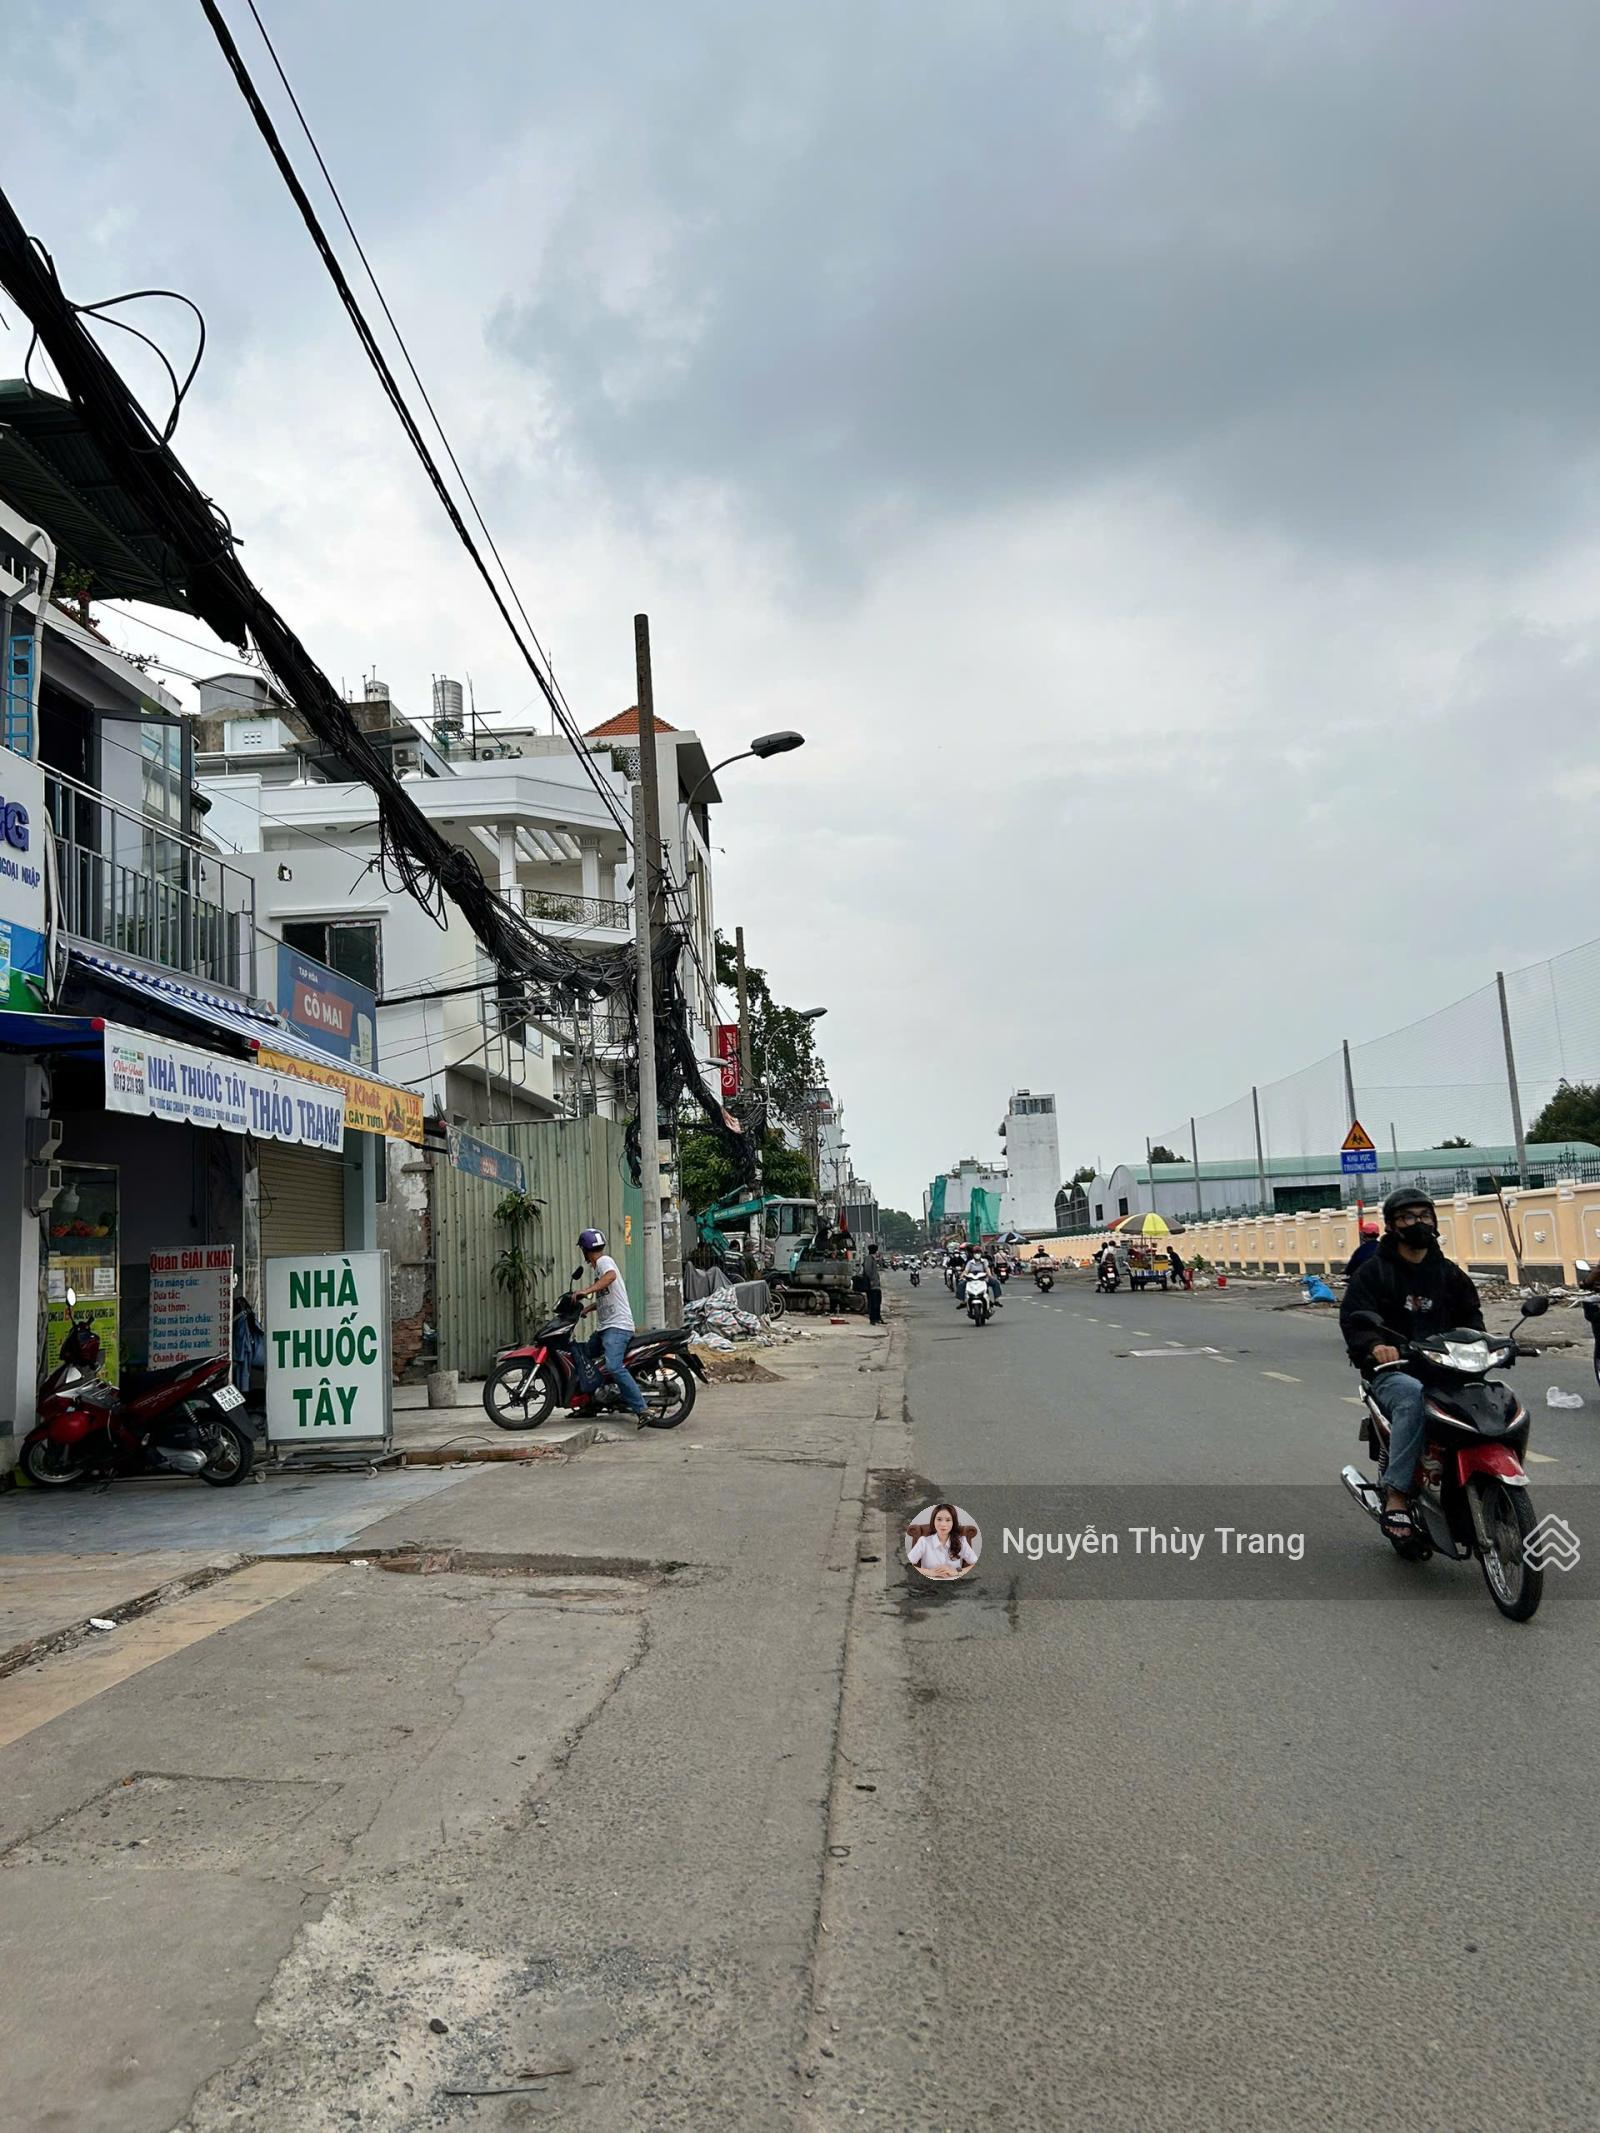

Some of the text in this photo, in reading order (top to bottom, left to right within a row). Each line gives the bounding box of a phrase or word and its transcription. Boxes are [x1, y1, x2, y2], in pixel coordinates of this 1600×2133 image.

[22, 866, 41, 889] NHẬP
[304, 993, 342, 1030] CÔ MAI
[148, 1055, 177, 1093] NHÀ
[180, 1061, 222, 1103] THUỐC
[225, 1072, 246, 1108] TÂY
[249, 1079, 293, 1135] THẢO
[297, 1099, 340, 1146] TRANG
[349, 1110, 364, 1125] CÂY
[150, 1253, 177, 1272] Quán
[181, 1248, 203, 1269] GIẢI
[289, 1258, 359, 1309] NHÀ
[272, 1312, 378, 1369] THUỐC
[293, 1377, 358, 1427] TÂY
